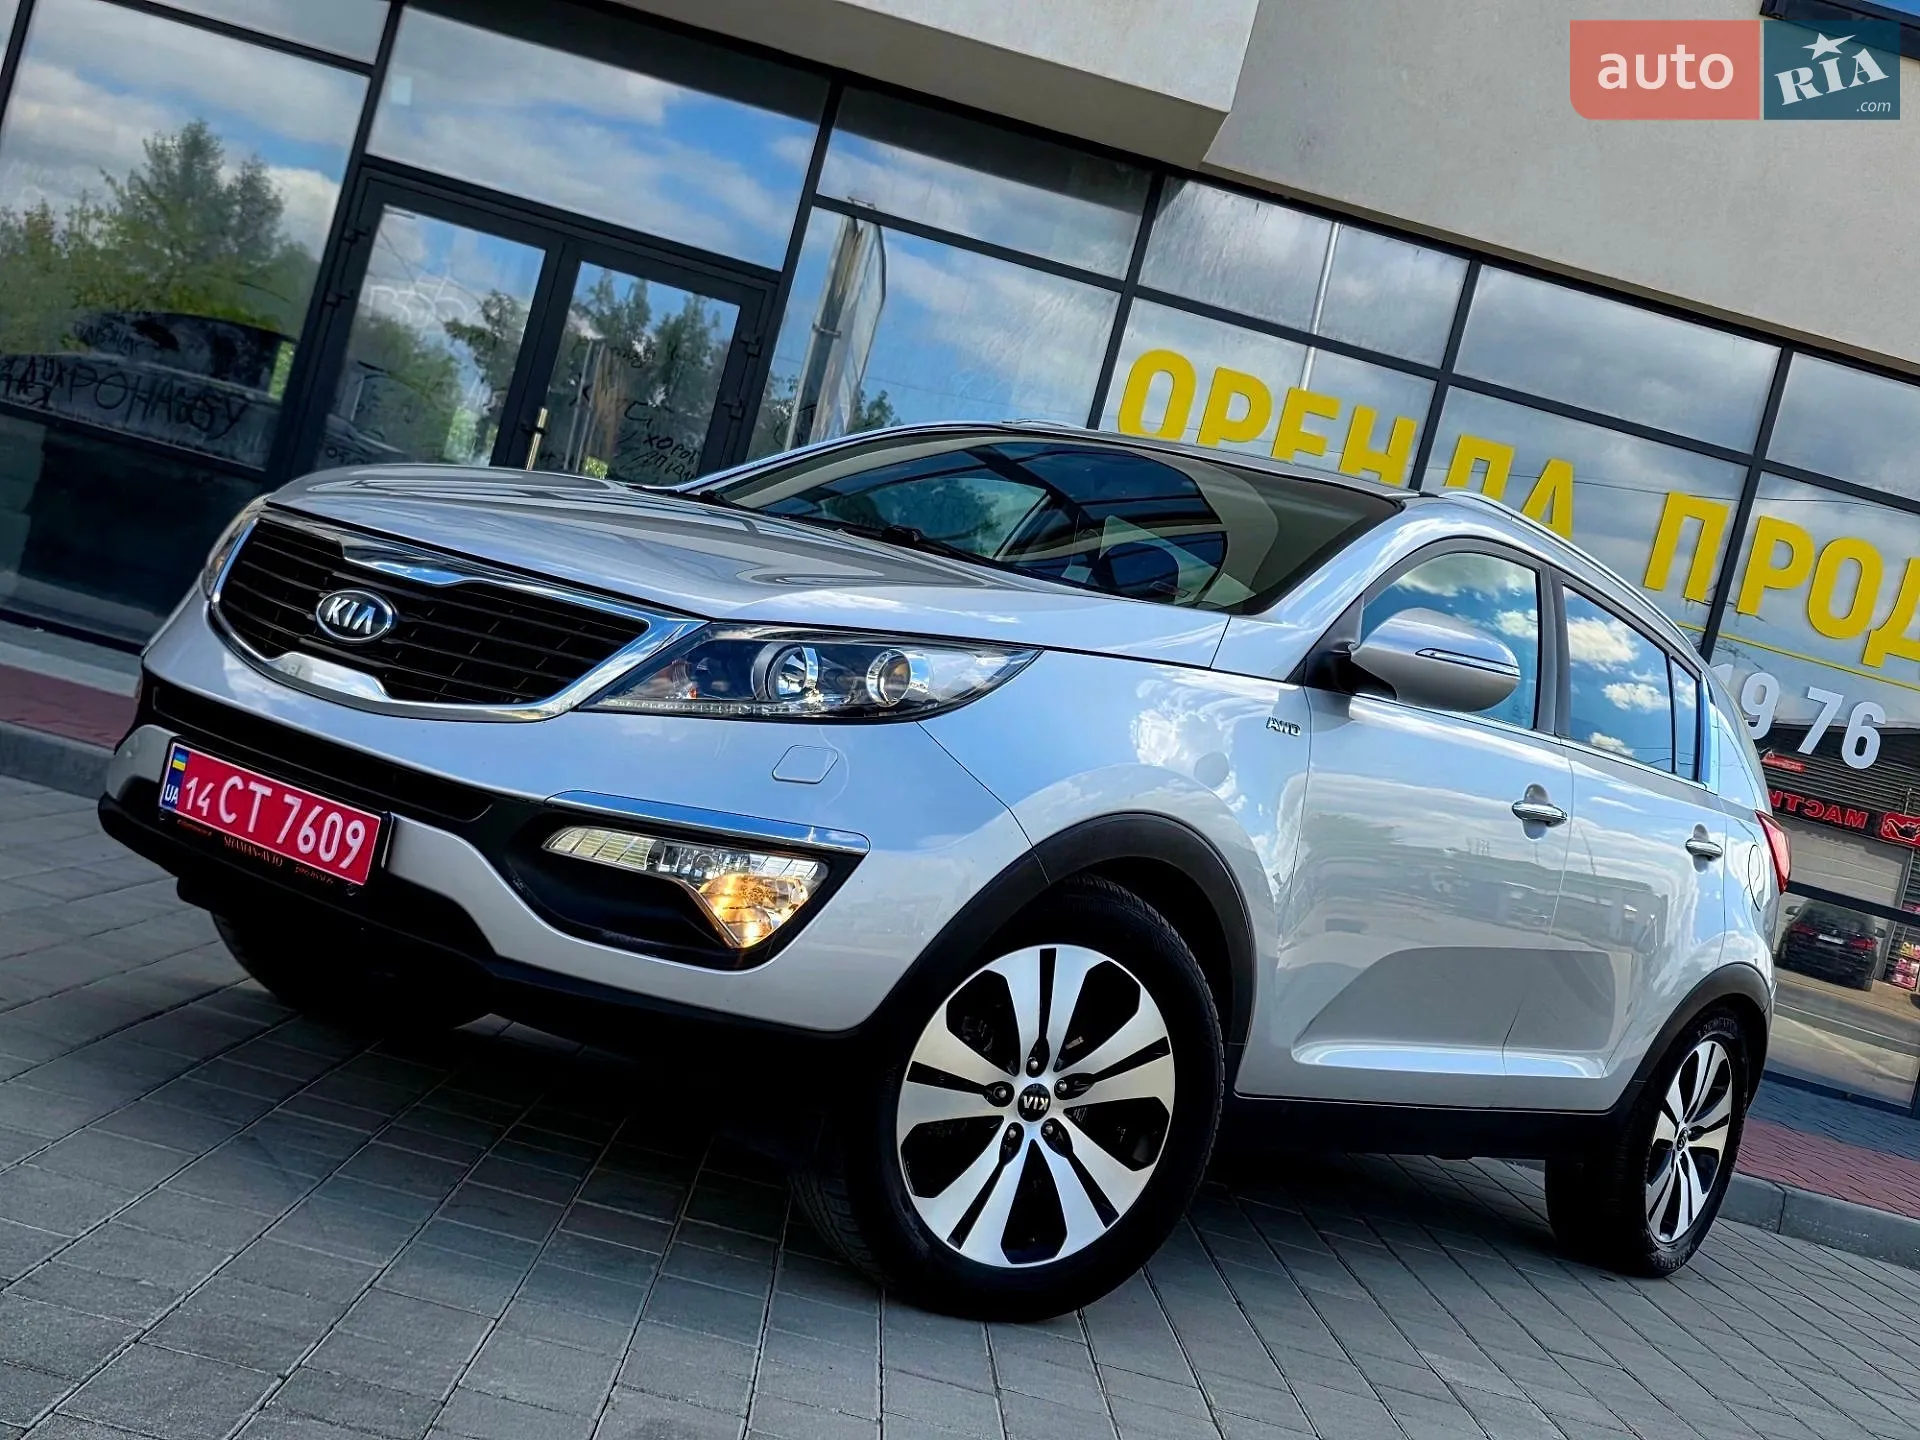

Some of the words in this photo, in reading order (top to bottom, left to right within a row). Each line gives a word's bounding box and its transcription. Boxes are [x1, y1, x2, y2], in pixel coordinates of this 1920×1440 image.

[325, 597, 376, 634] KIA
[1265, 716, 1301, 737] AWD
[164, 783, 179, 805] UA
[276, 793, 366, 870] 7609
